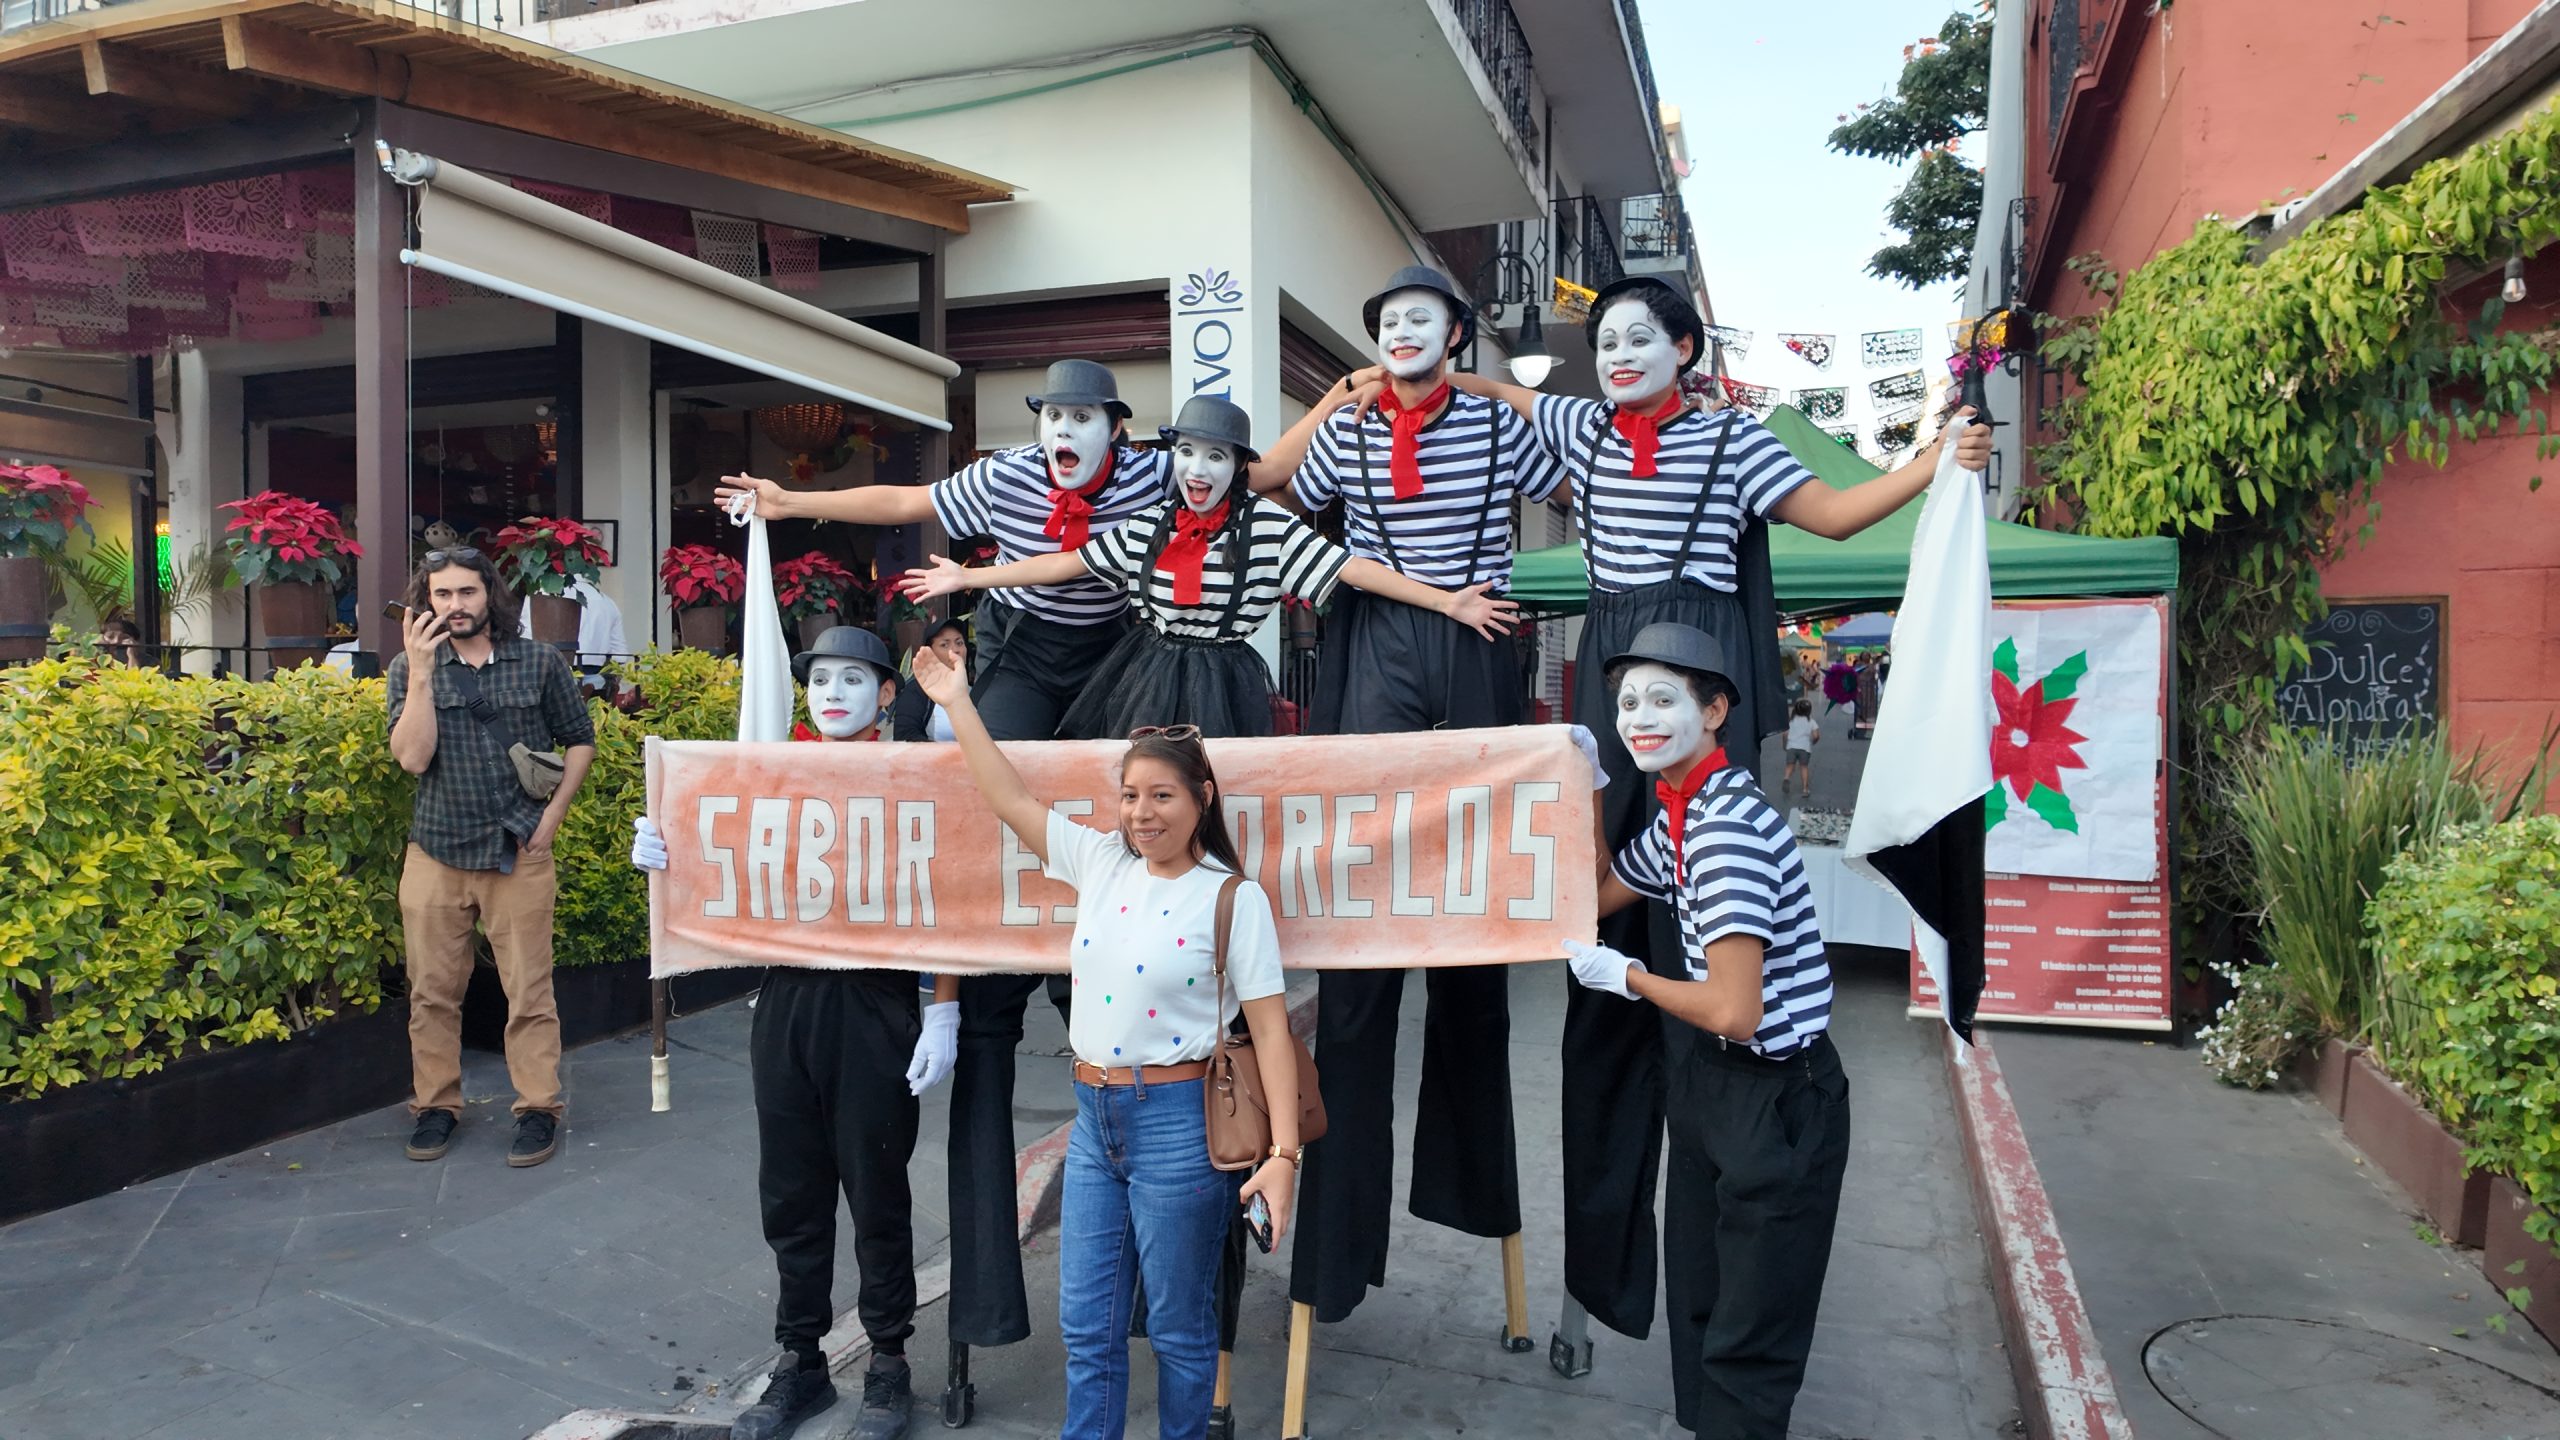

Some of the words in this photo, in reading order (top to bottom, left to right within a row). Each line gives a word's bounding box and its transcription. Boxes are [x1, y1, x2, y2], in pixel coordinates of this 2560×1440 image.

[1193, 319, 1232, 402] VO
[2297, 643, 2413, 685] Dulce
[2283, 684, 2412, 723] Alondra
[698, 795, 936, 927] SABOR
[1223, 781, 1560, 921] ORELOS
[2104, 884, 2115, 893] de
[1993, 898, 2026, 907] diversos
[2130, 895, 2160, 903] madera
[2055, 926, 2079, 936] Cobre
[2077, 963, 2087, 971] de
[2138, 964, 2161, 973] sobre
[2106, 973, 2115, 982] lo
[2116, 974, 2131, 983] que
